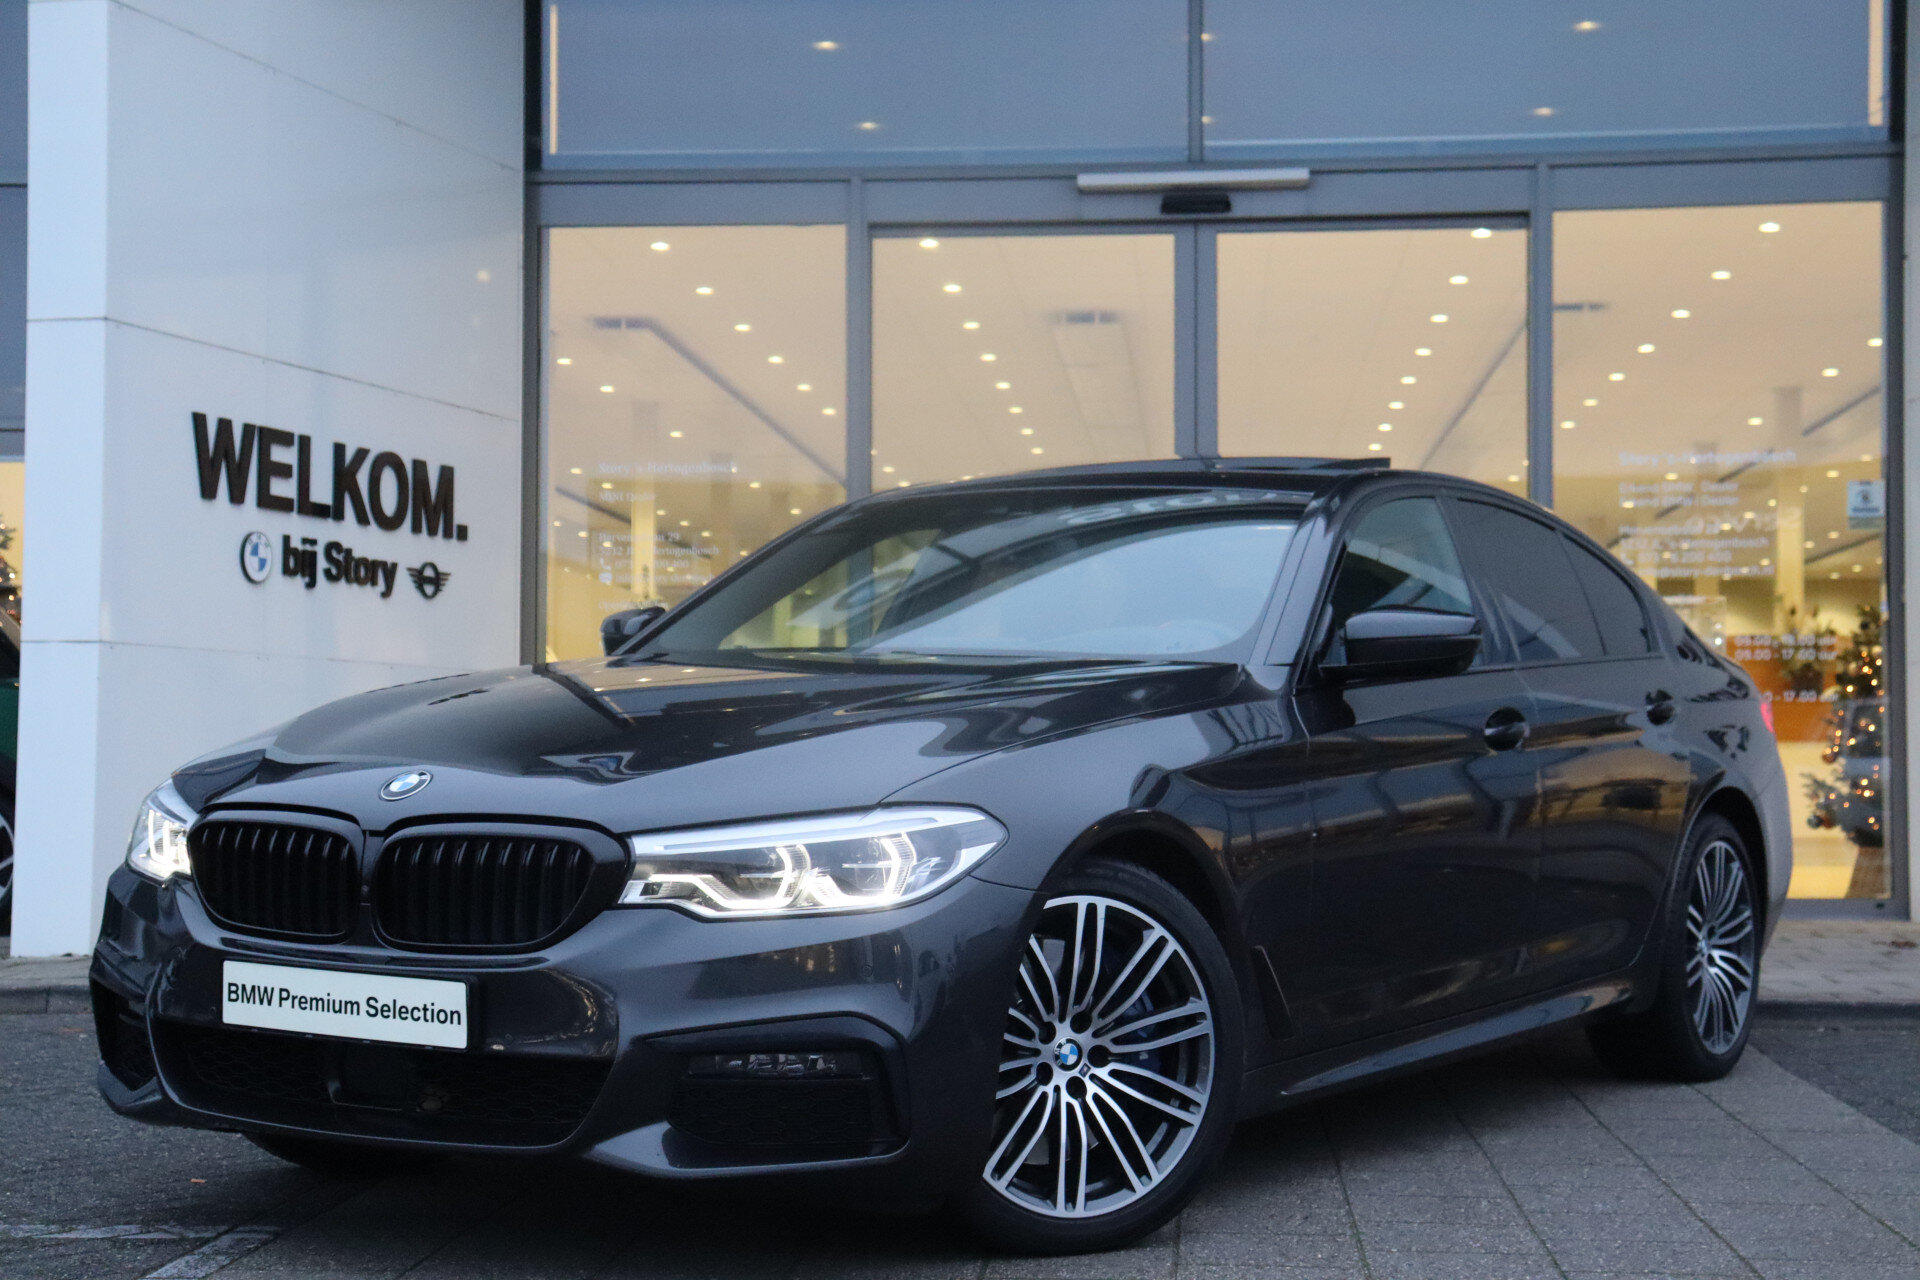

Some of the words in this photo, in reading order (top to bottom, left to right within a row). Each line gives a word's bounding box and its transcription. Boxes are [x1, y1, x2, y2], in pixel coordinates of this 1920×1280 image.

[191, 411, 468, 541] WELKOM.
[323, 541, 398, 599] Story
[227, 982, 274, 1007] BMW
[278, 988, 361, 1016] Premium
[366, 997, 462, 1026] Selection
